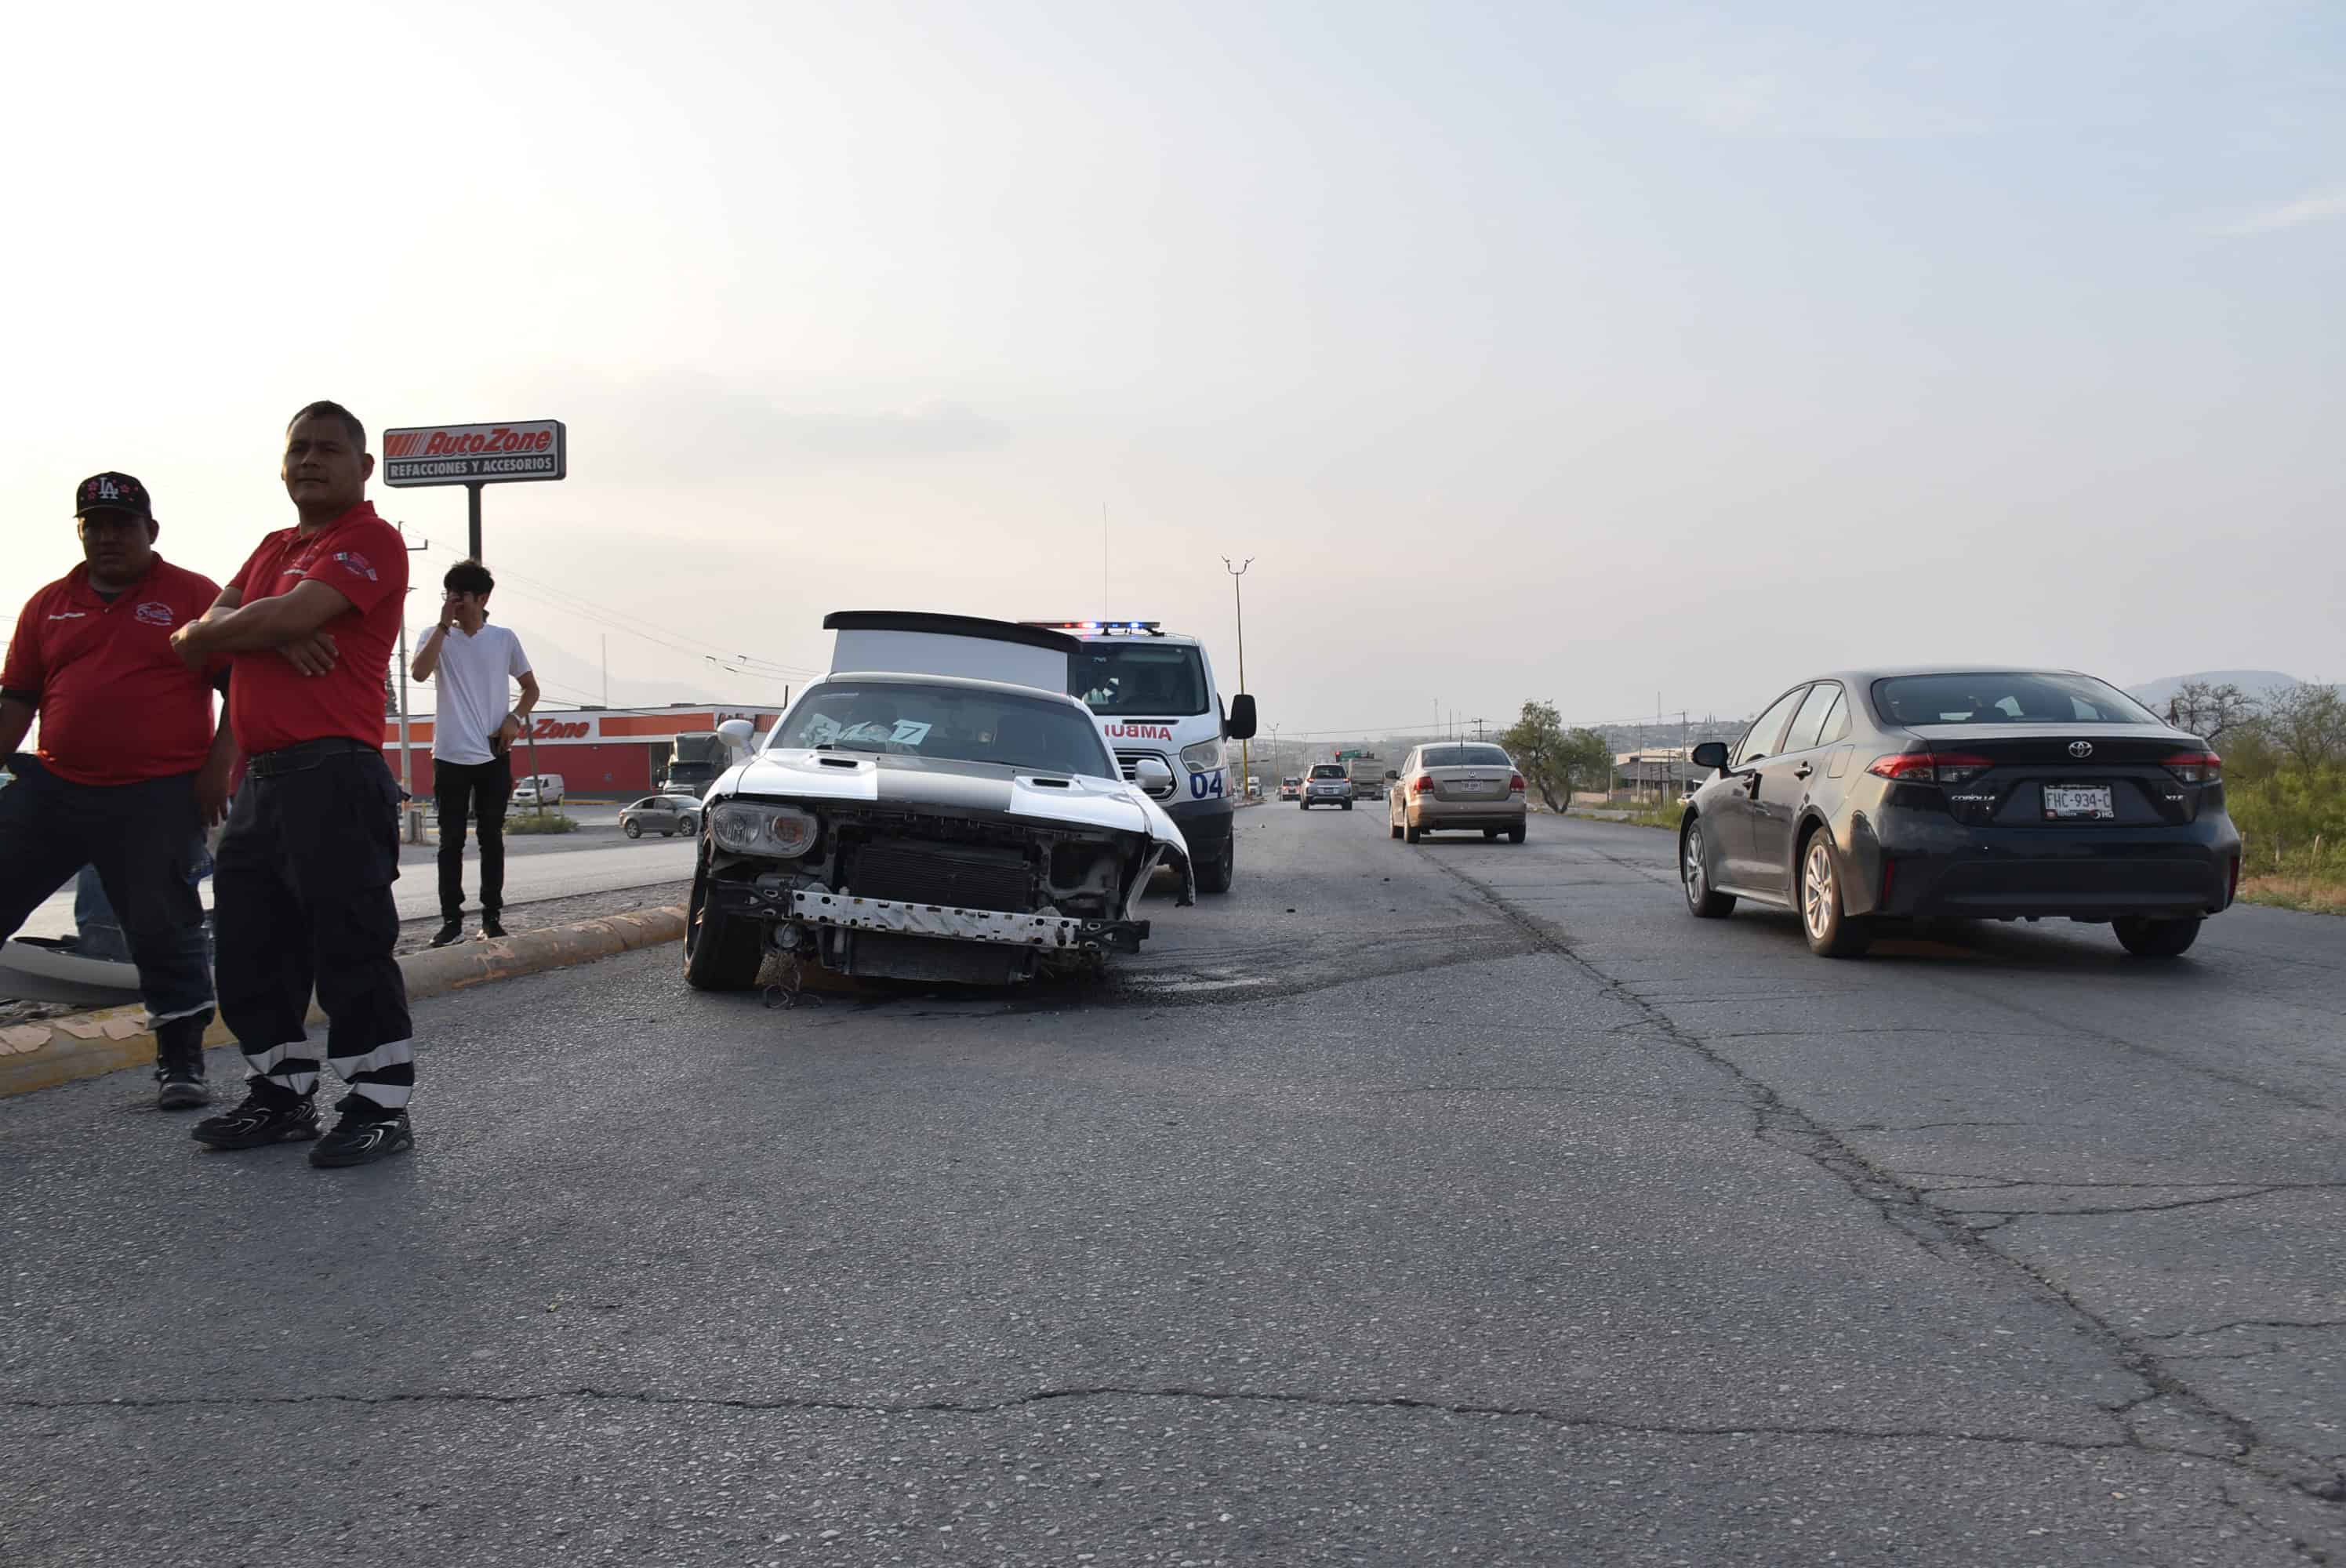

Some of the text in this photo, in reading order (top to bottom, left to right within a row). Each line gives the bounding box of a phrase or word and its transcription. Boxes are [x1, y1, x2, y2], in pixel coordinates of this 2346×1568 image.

[424, 428, 553, 455] AutoZone
[390, 457, 552, 477] REFACCIONES Y ACCESORIOS
[100, 477, 118, 499] LA
[1189, 771, 1223, 799] 04
[2046, 793, 2111, 808] FHC-934-C
